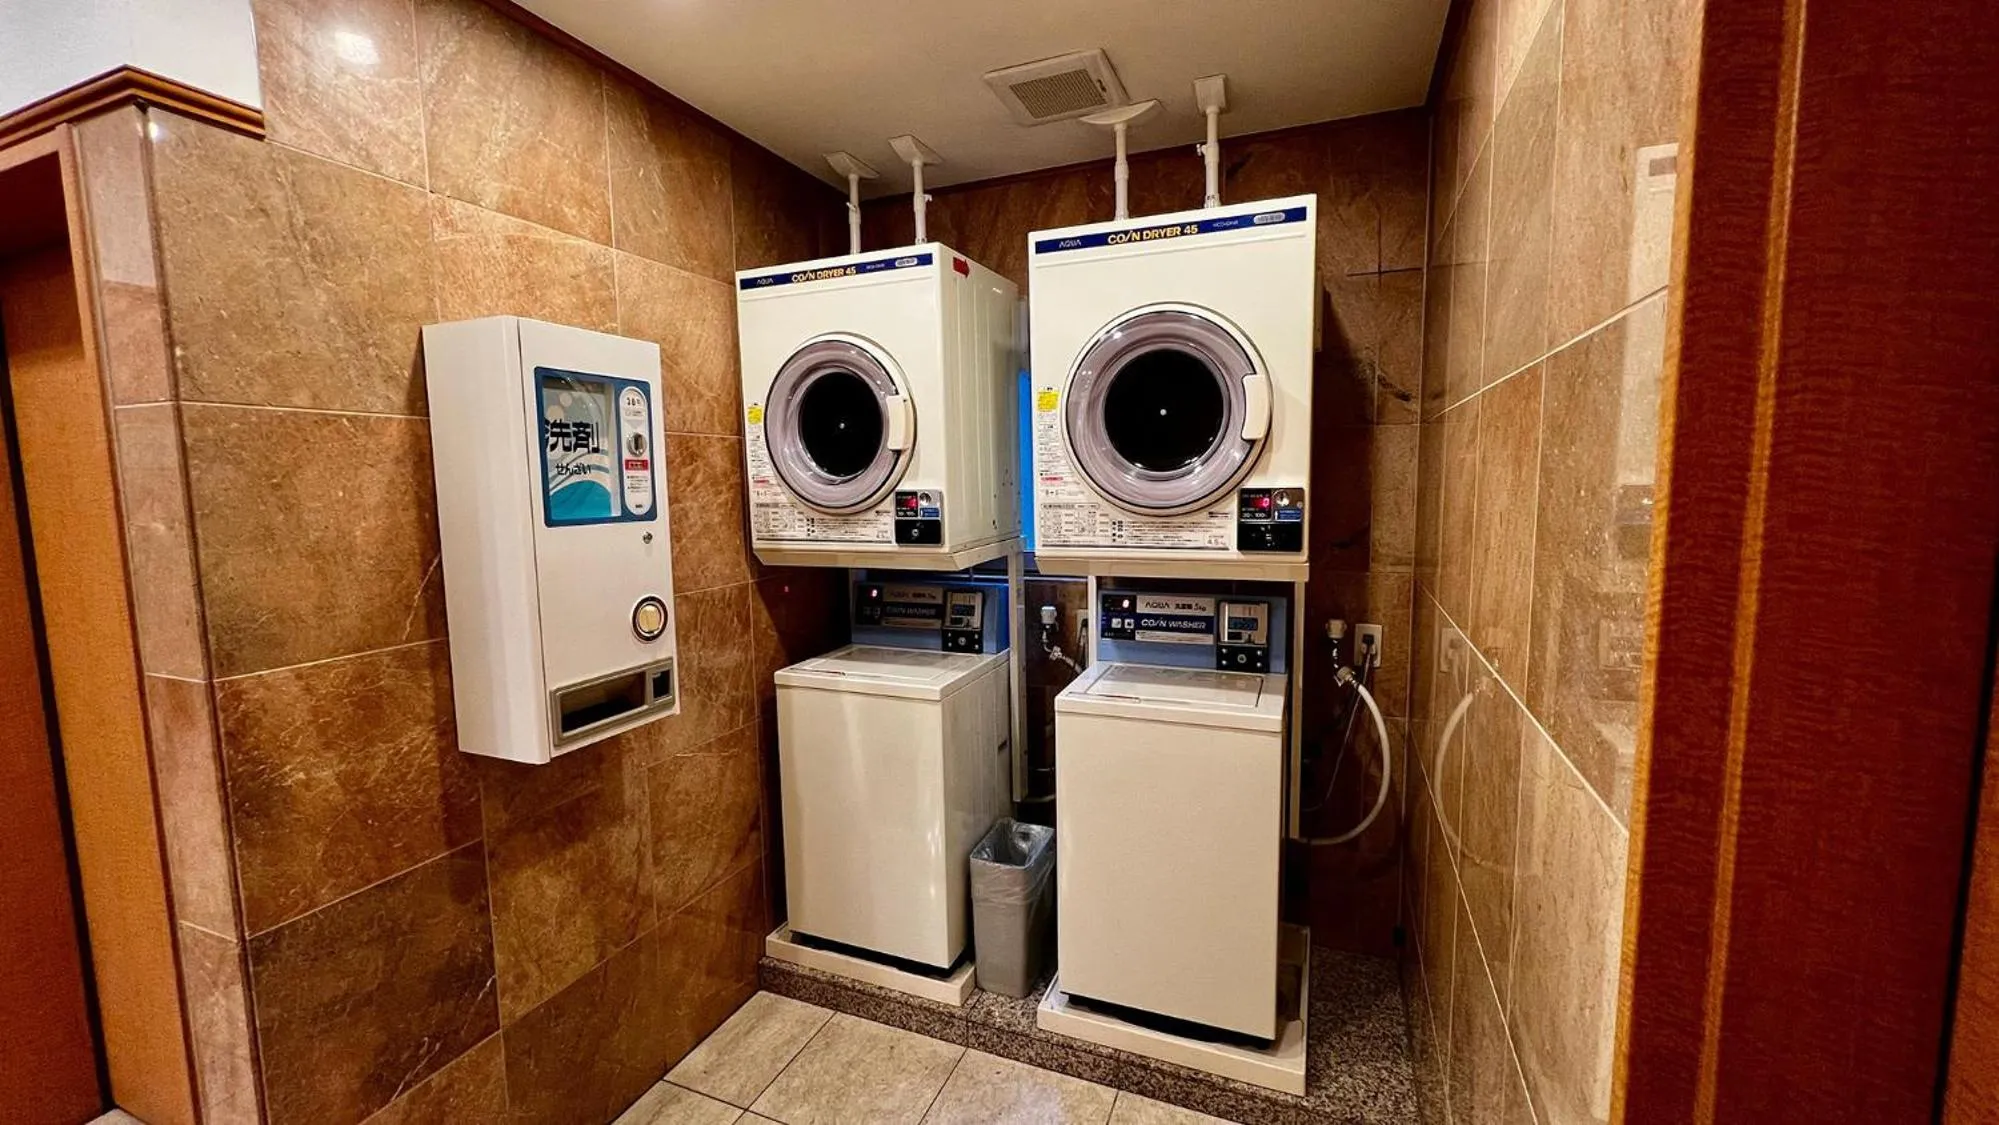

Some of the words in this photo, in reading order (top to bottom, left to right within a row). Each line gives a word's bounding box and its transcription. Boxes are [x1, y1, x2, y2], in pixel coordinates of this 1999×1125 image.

[1142, 226, 1181, 241] DRYER
[1183, 224, 1198, 234] 45
[1058, 239, 1082, 249] AQUA
[816, 267, 845, 280] DRYER
[845, 266, 857, 275] 45
[544, 418, 600, 454] 洗剤
[555, 462, 592, 476] せんざい
[1145, 601, 1170, 610] AQUA
[1168, 620, 1207, 630] WASHER
